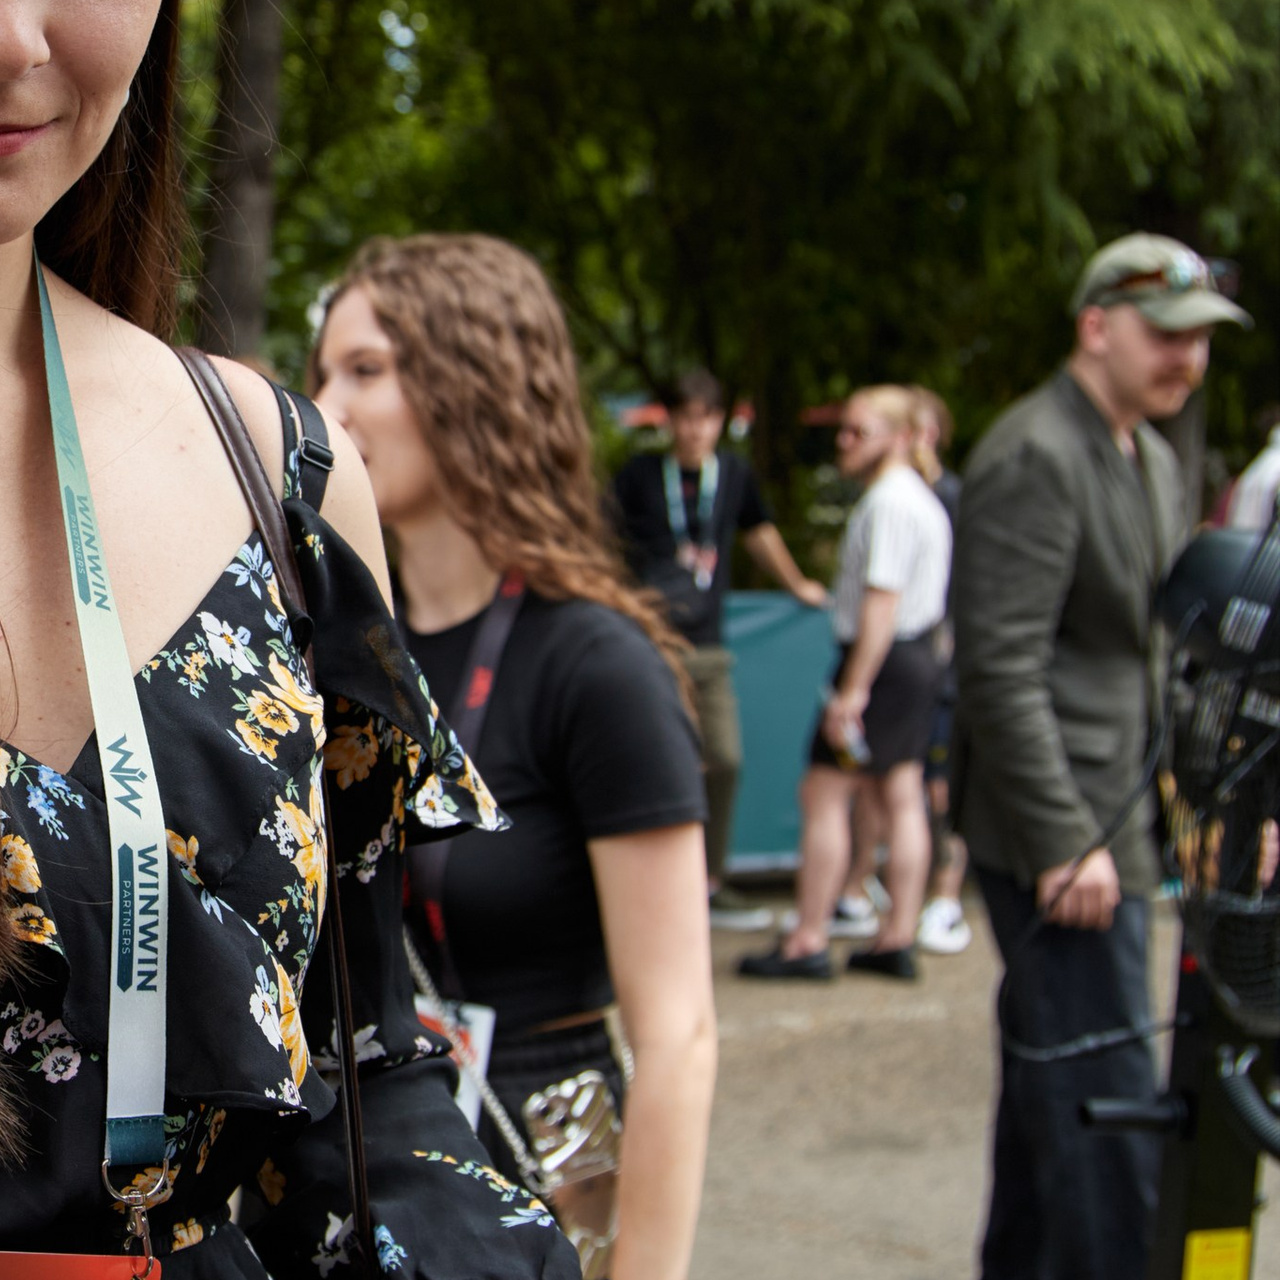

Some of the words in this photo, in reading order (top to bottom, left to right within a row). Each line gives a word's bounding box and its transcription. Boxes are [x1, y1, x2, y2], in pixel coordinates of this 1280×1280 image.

[70, 514, 86, 575] PARTNERS
[76, 495, 111, 612] WINWIN
[122, 880, 132, 955] PARTNERS
[136, 843, 159, 992] WINWIN
